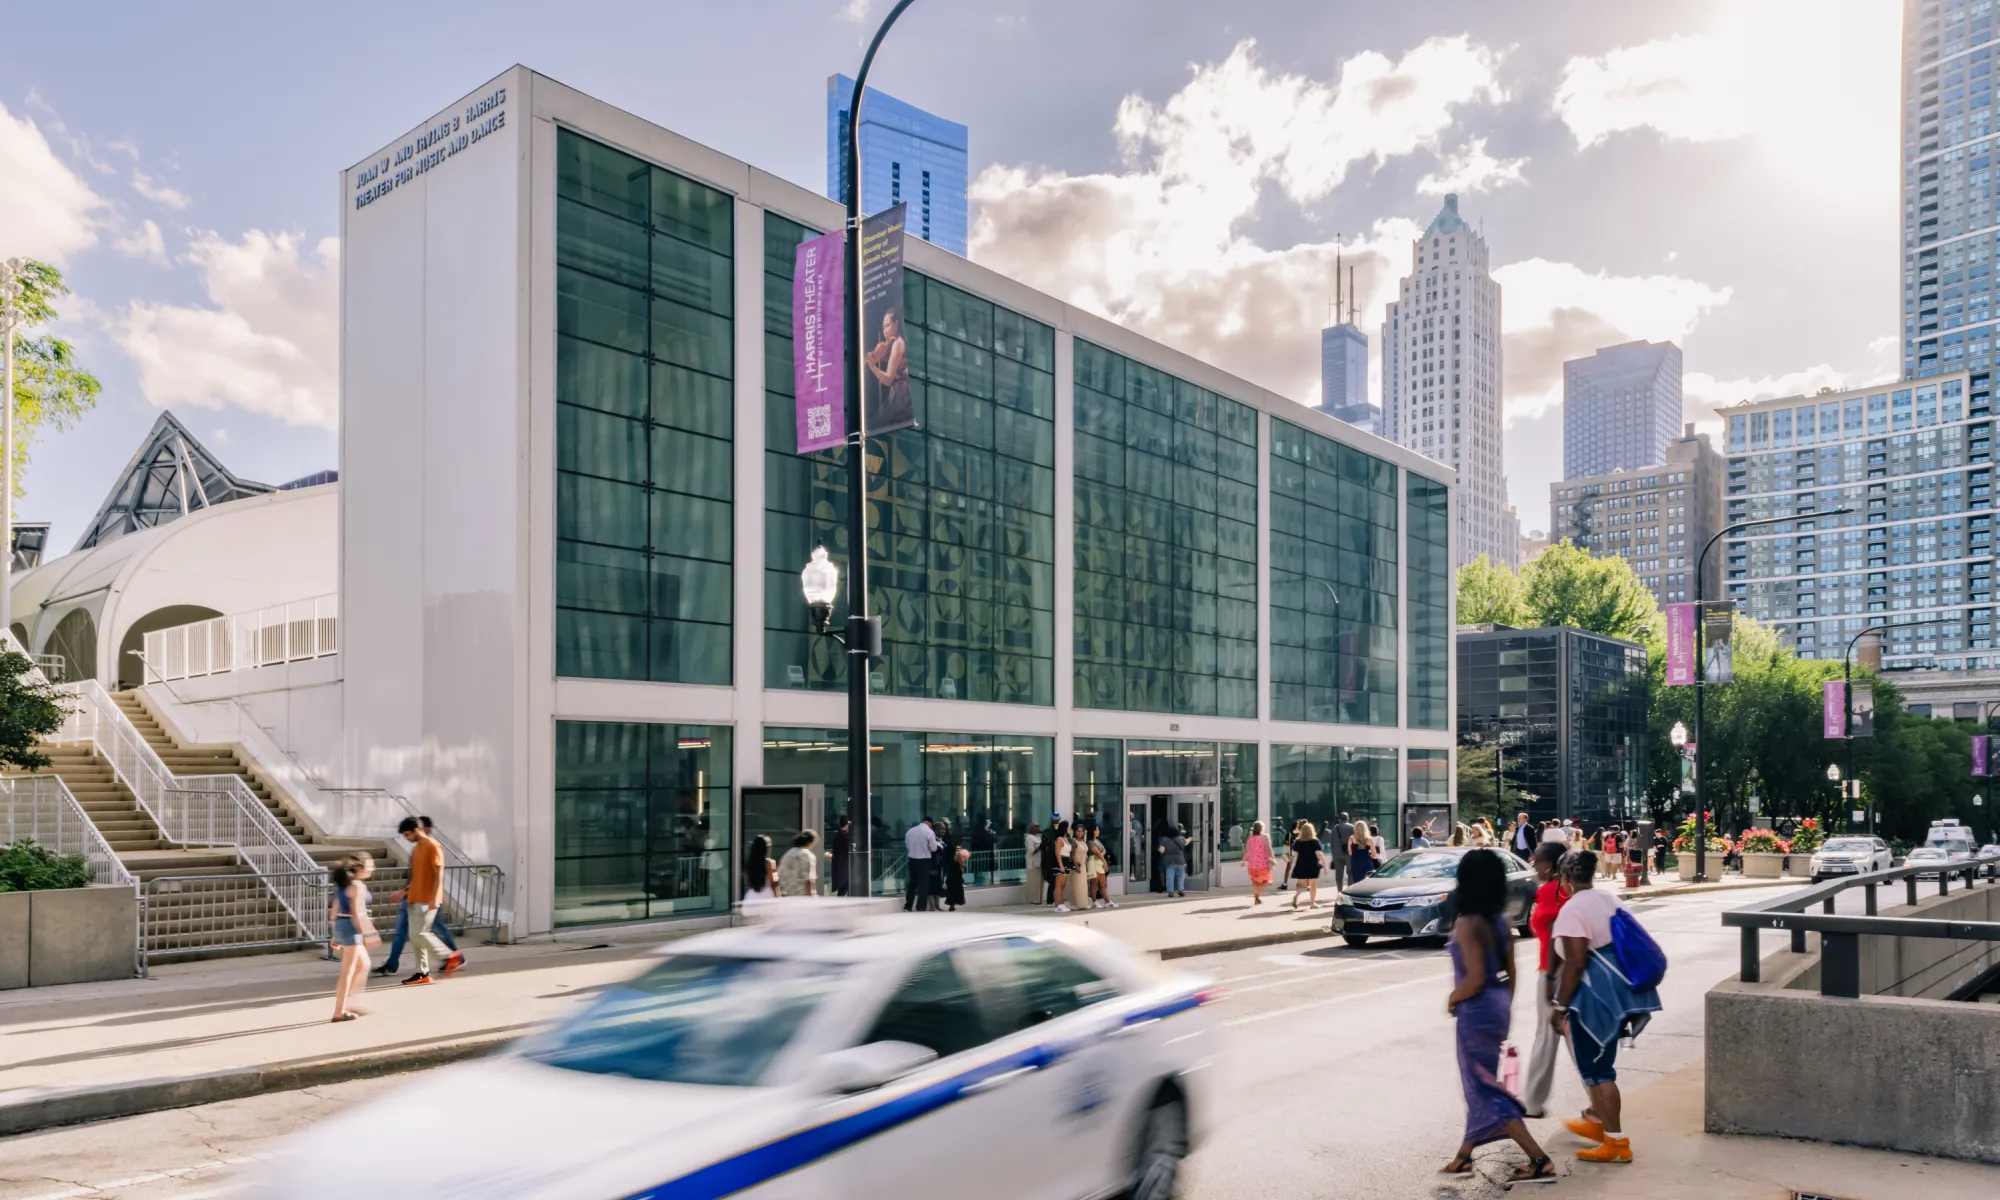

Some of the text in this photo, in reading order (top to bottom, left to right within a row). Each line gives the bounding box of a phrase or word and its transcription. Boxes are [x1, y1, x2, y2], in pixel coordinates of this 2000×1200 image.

[354, 111, 506, 210] THEATER FOR MUSIC AND DANCE
[356, 164, 378, 189] JOAN
[394, 144, 413, 167] AND
[415, 122, 450, 154] IRVING
[465, 88, 506, 124] HARRIS
[863, 238, 889, 256] Society of
[881, 245, 900, 258] Center
